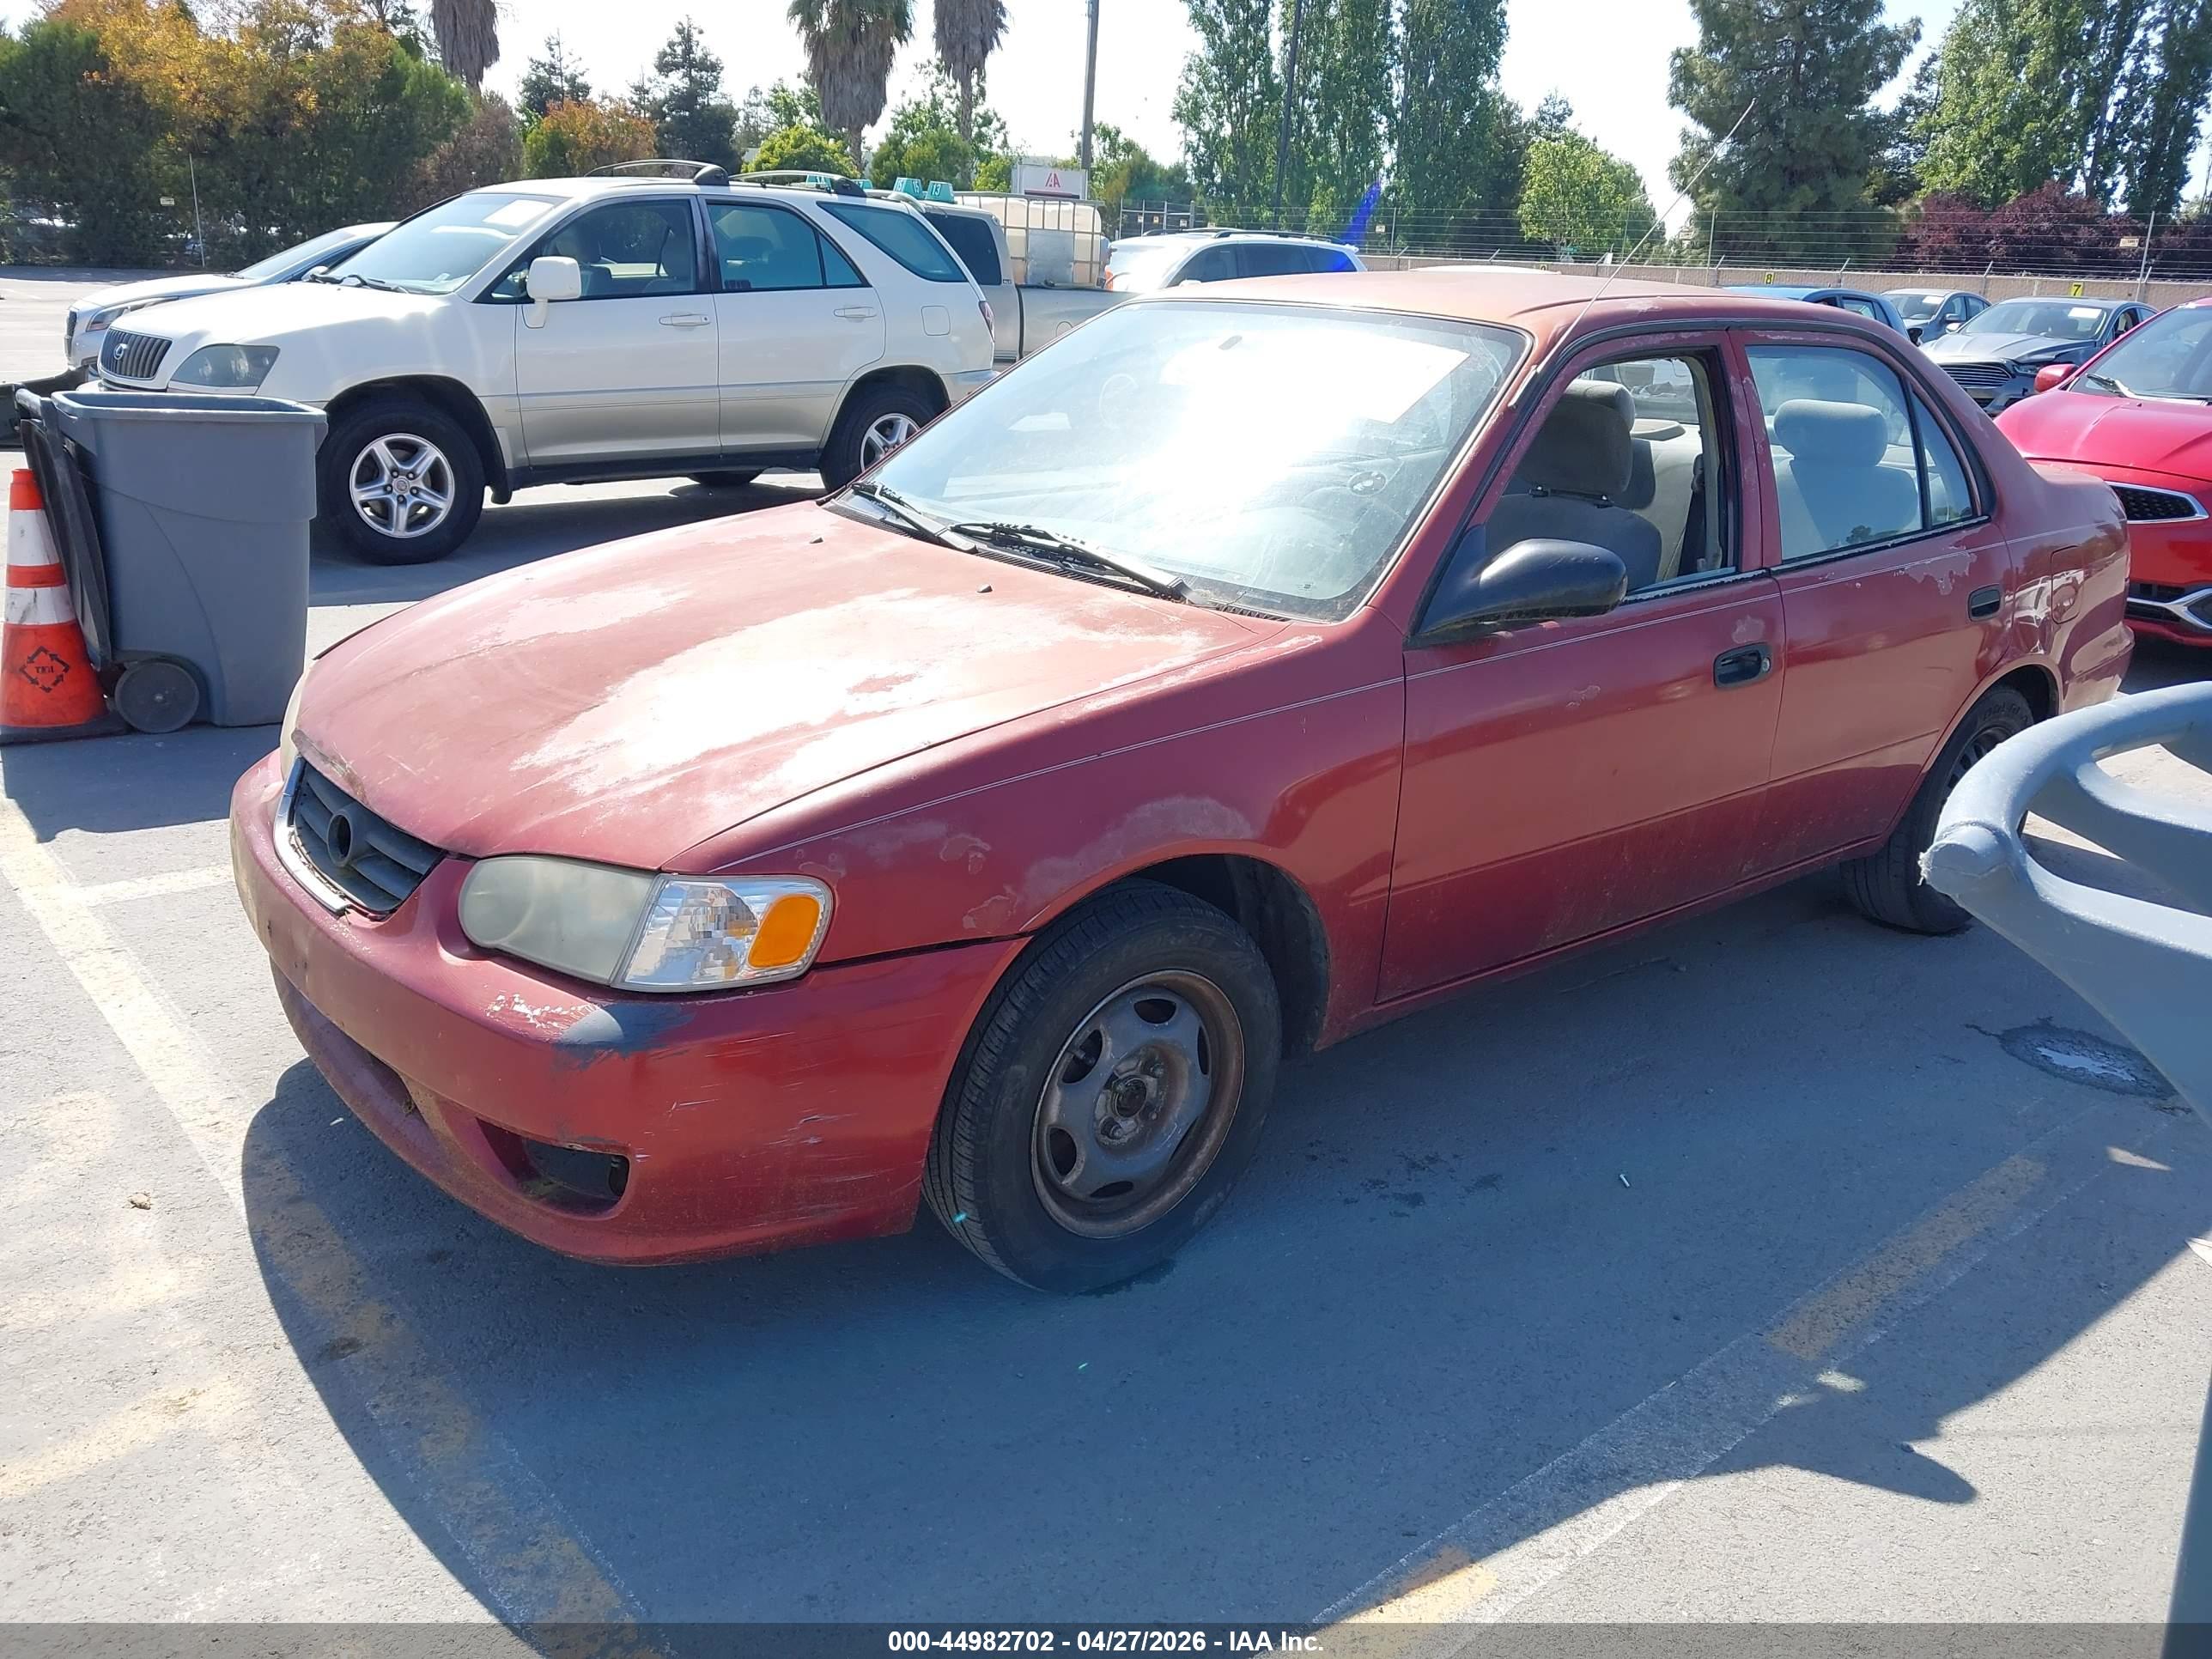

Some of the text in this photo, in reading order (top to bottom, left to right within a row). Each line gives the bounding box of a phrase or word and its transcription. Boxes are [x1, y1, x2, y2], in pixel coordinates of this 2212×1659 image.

[932, 184, 941, 196] 13
[1766, 273, 1772, 284] 8
[2073, 284, 2081, 296] 7
